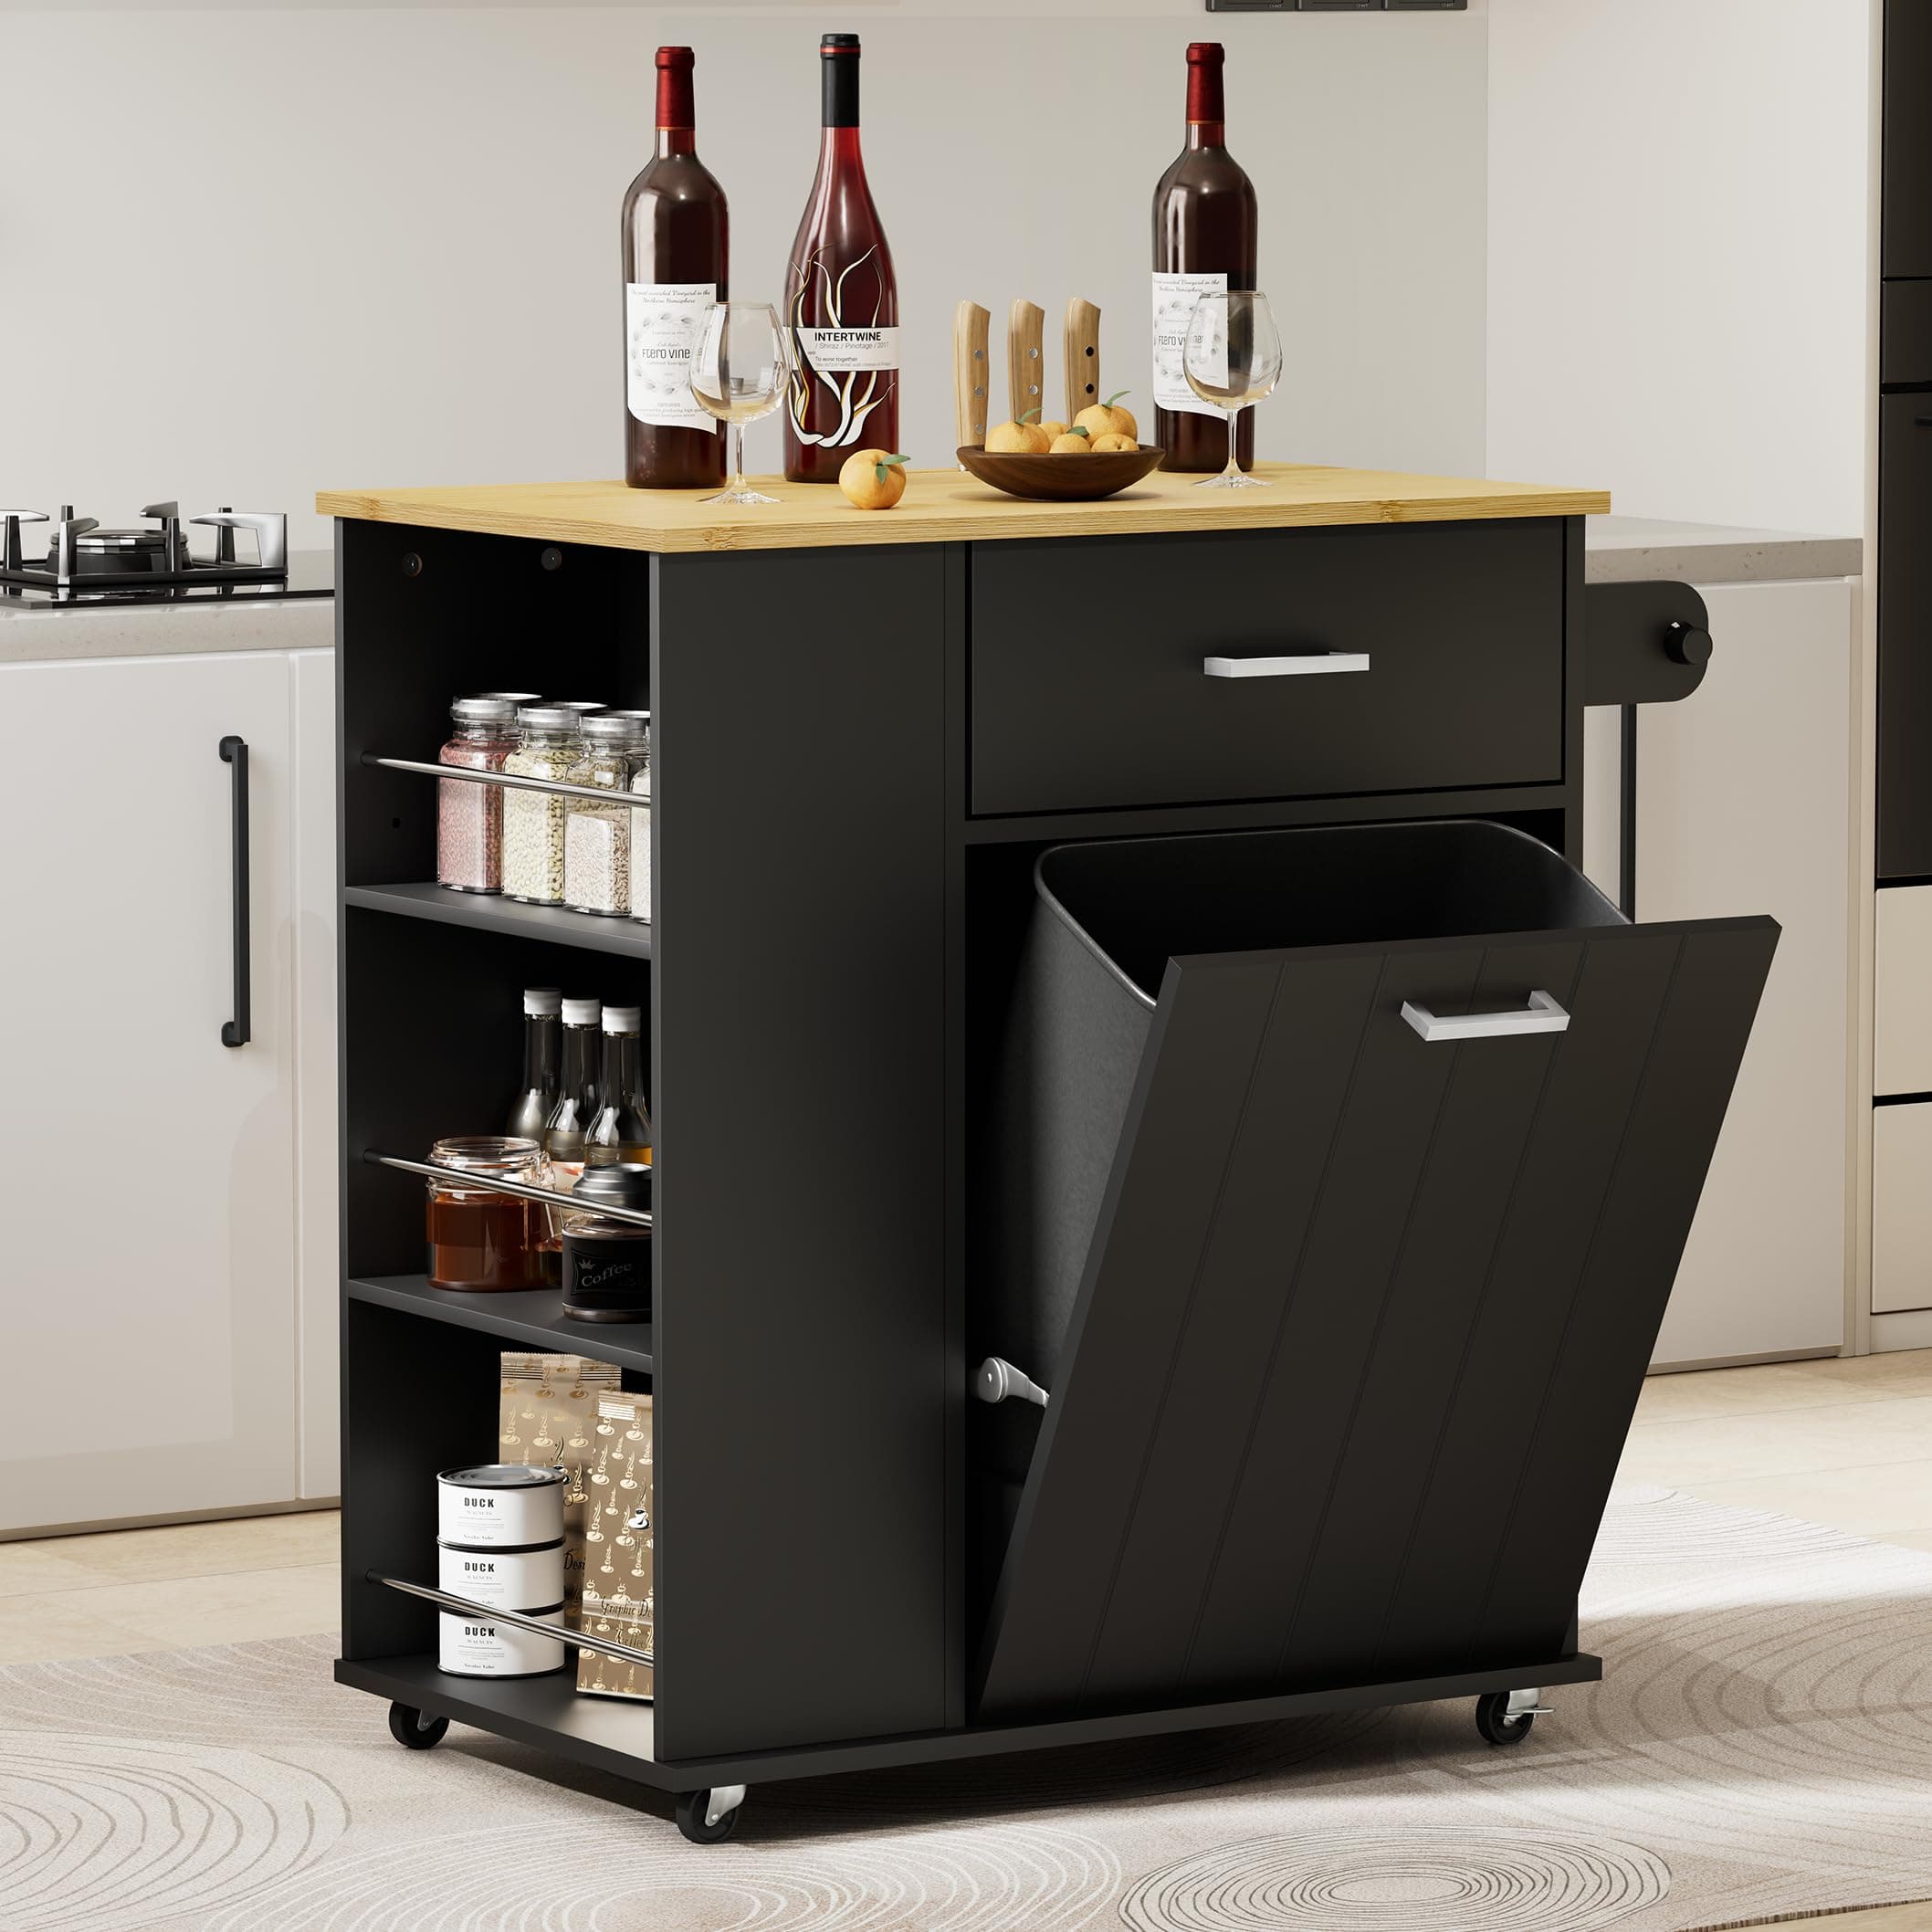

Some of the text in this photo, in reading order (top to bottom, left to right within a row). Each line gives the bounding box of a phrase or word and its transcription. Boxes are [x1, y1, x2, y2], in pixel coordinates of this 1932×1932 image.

[814, 331, 881, 341] INTERTWINE
[845, 342, 873, 351] Pinotage
[582, 1263, 632, 1286] Coffee
[464, 1496, 495, 1508] DUCK
[464, 1561, 496, 1573] DUCK
[601, 1595, 636, 1619] Graphic
[465, 1626, 496, 1637] DUCK
